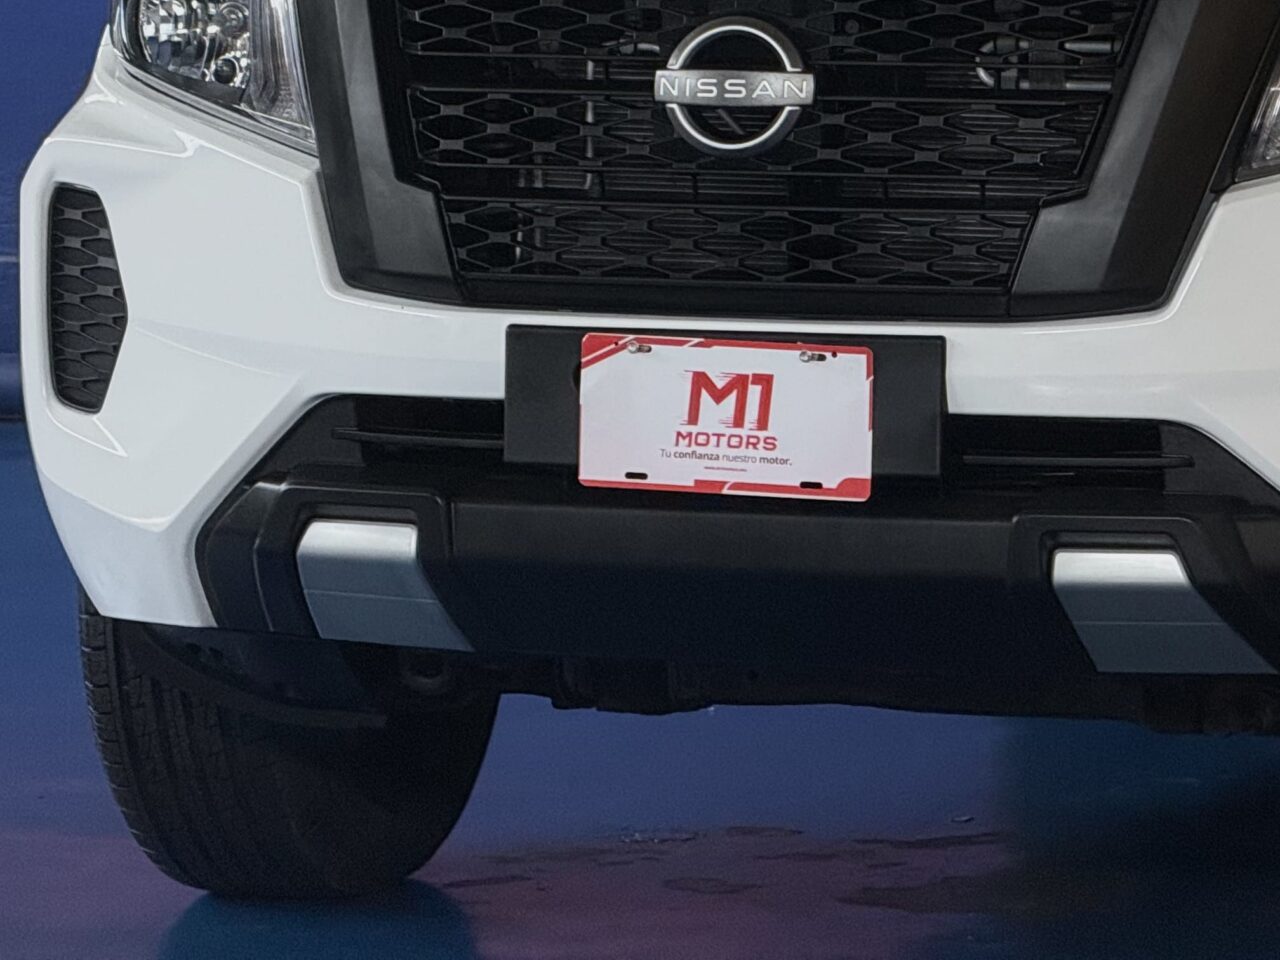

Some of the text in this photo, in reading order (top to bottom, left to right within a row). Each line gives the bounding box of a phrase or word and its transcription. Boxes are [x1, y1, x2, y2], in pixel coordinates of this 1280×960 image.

[659, 76, 808, 99] NISSAN
[680, 370, 775, 432] M1
[674, 430, 778, 452] MOTORS
[660, 448, 793, 467] Tu confianza nuestro motor.
